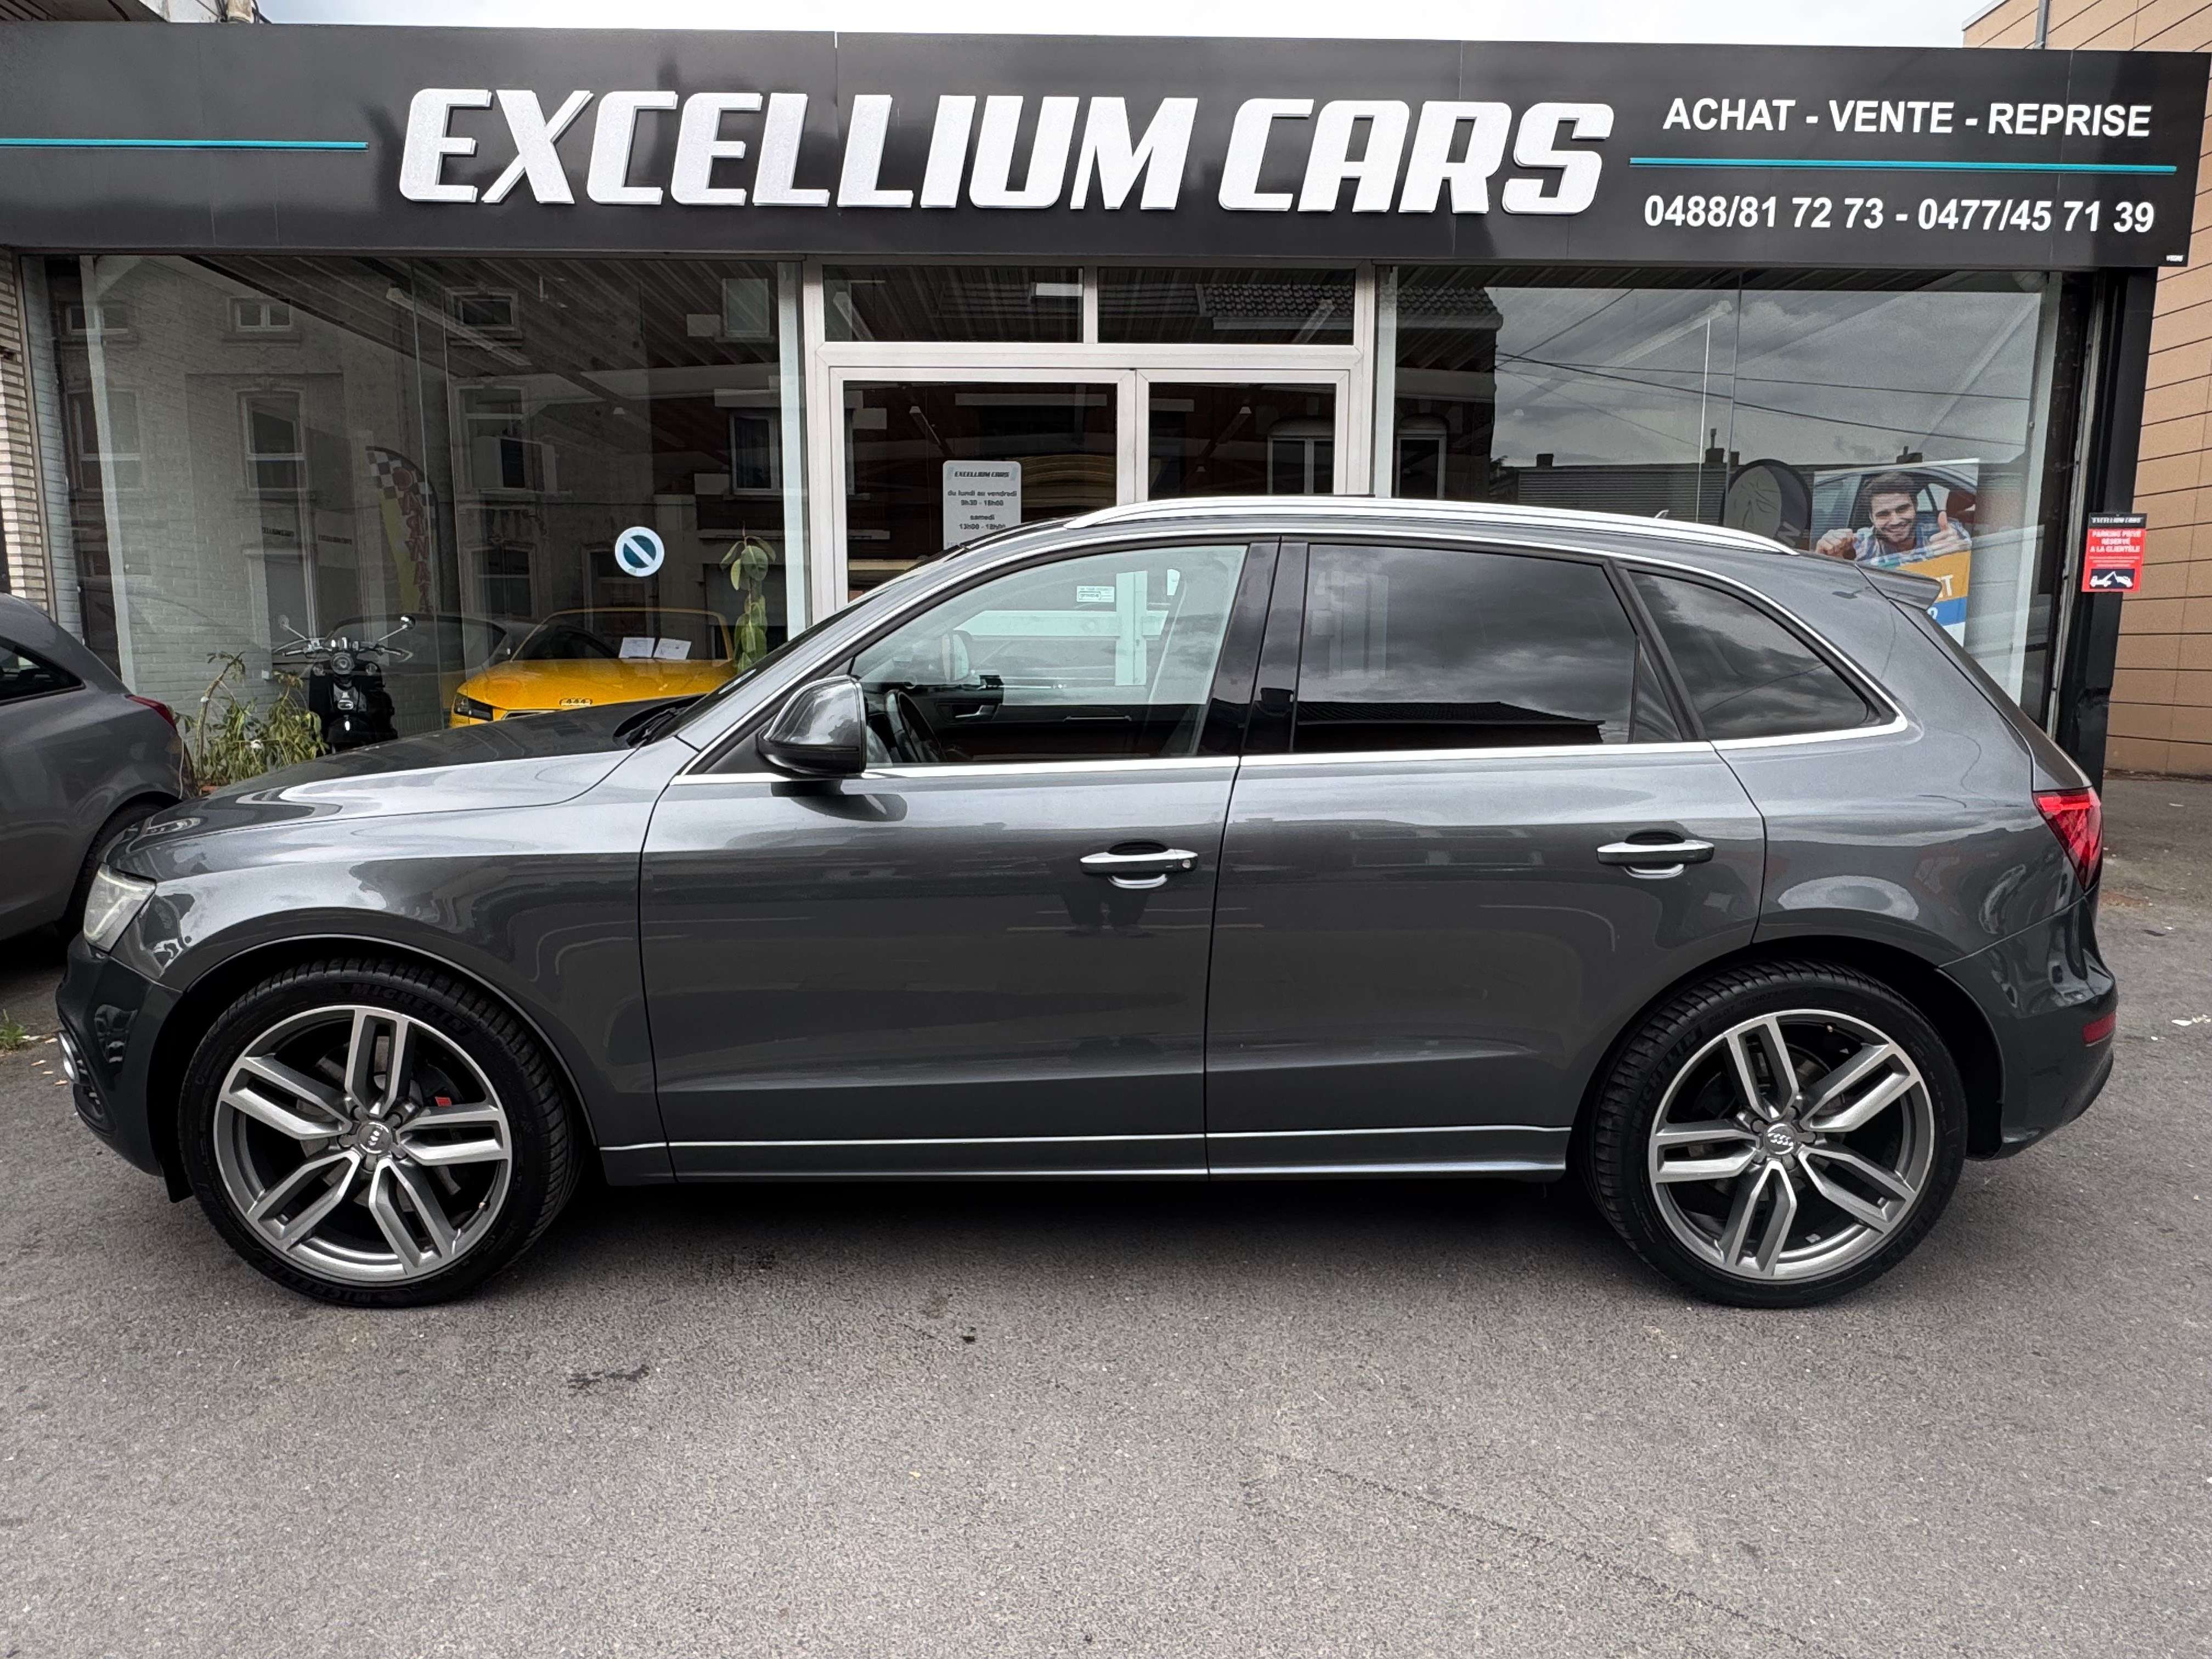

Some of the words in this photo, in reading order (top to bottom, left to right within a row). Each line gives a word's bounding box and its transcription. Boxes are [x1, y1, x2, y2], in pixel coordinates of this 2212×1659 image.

[1662, 98, 1796, 131] ACHAT
[1805, 115, 1818, 124] -
[1829, 100, 1954, 133] VENTE
[1965, 117, 1978, 126] -
[1988, 103, 2152, 137] REPRISE
[399, 88, 1198, 210] EXCELLIUM
[1218, 98, 1615, 215] CARS
[1645, 195, 1776, 227] 0488/81
[1792, 197, 1832, 228] 72
[1844, 198, 1883, 229] 73
[1918, 198, 2052, 231] 0477/45
[2063, 201, 2101, 232] 71
[2113, 201, 2155, 233] 39
